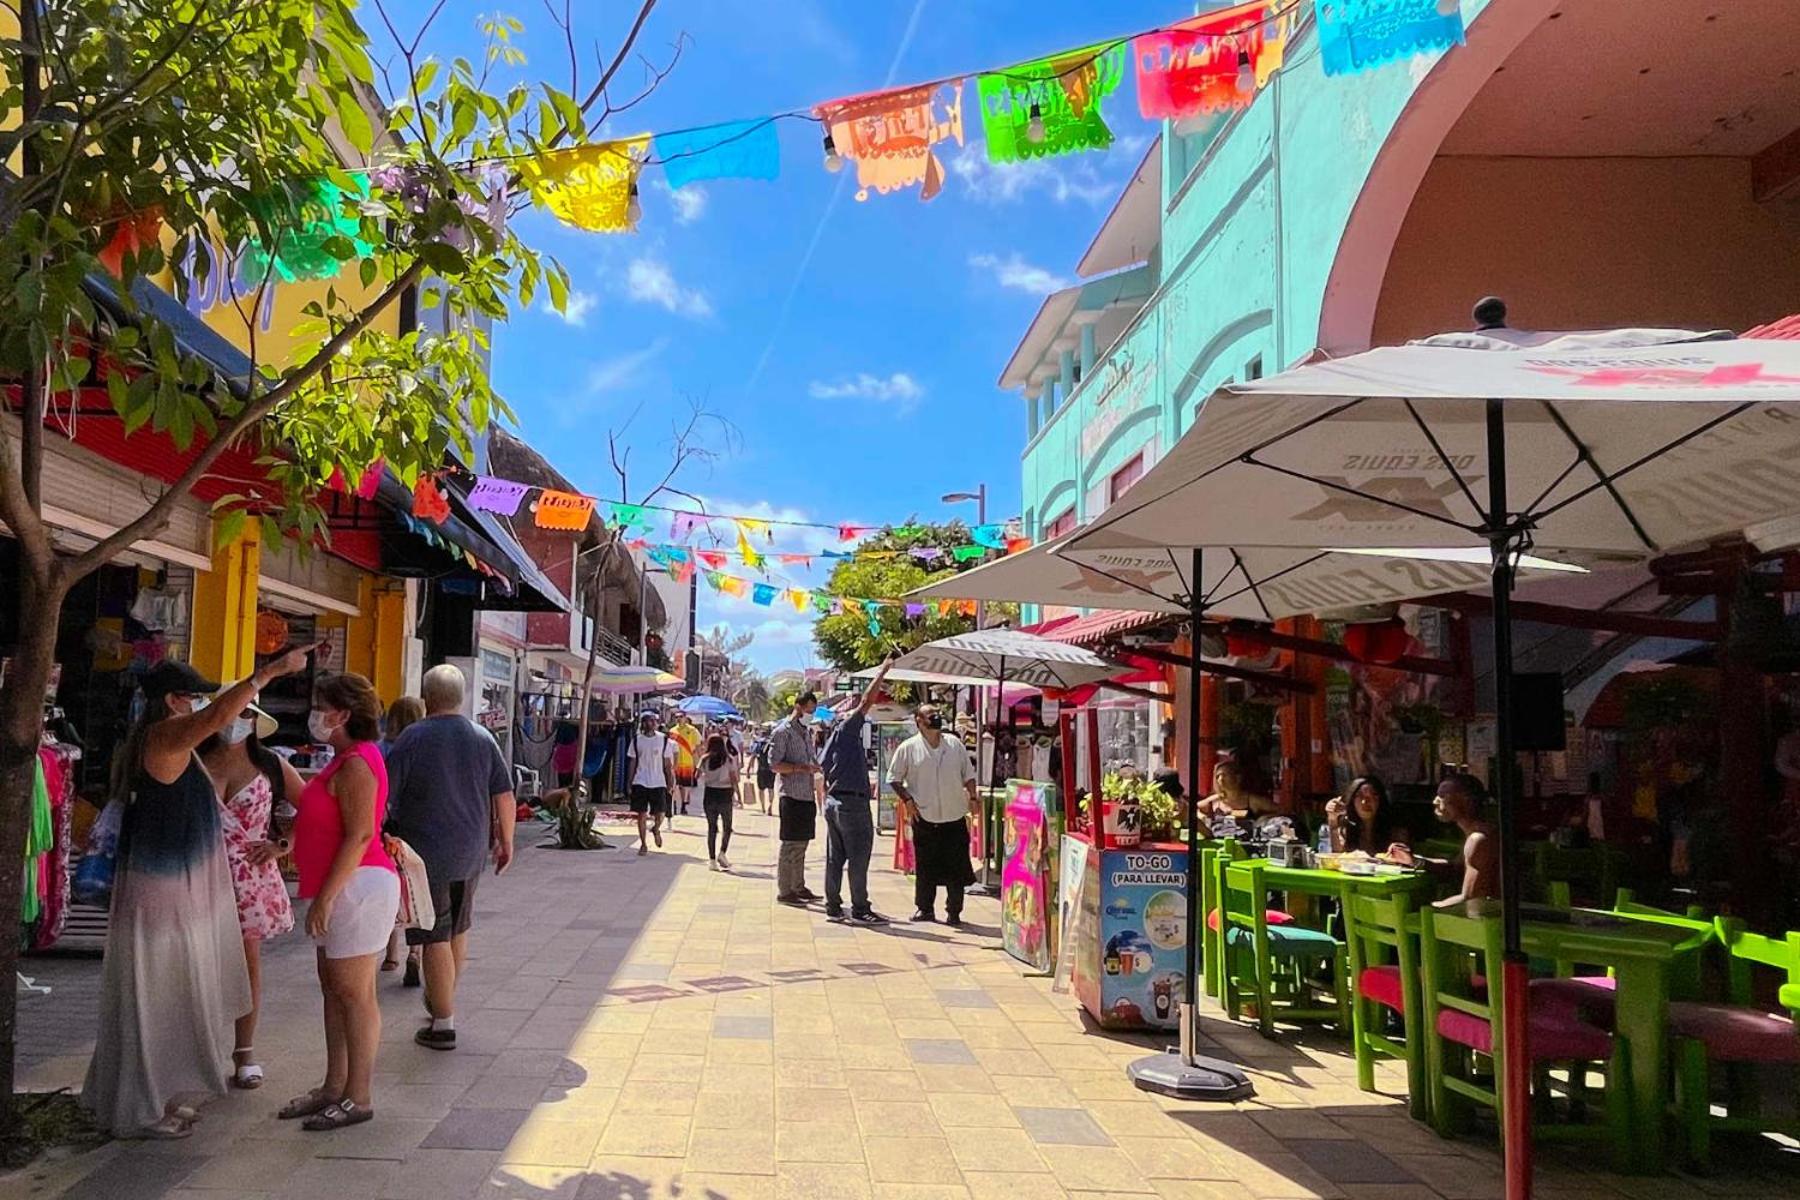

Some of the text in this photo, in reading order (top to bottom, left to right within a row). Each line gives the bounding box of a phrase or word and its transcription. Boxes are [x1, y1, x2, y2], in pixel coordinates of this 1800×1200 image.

[1126, 855, 1171, 870] TO-GO
[1112, 872, 1187, 887] (PARA LLEVAR)
